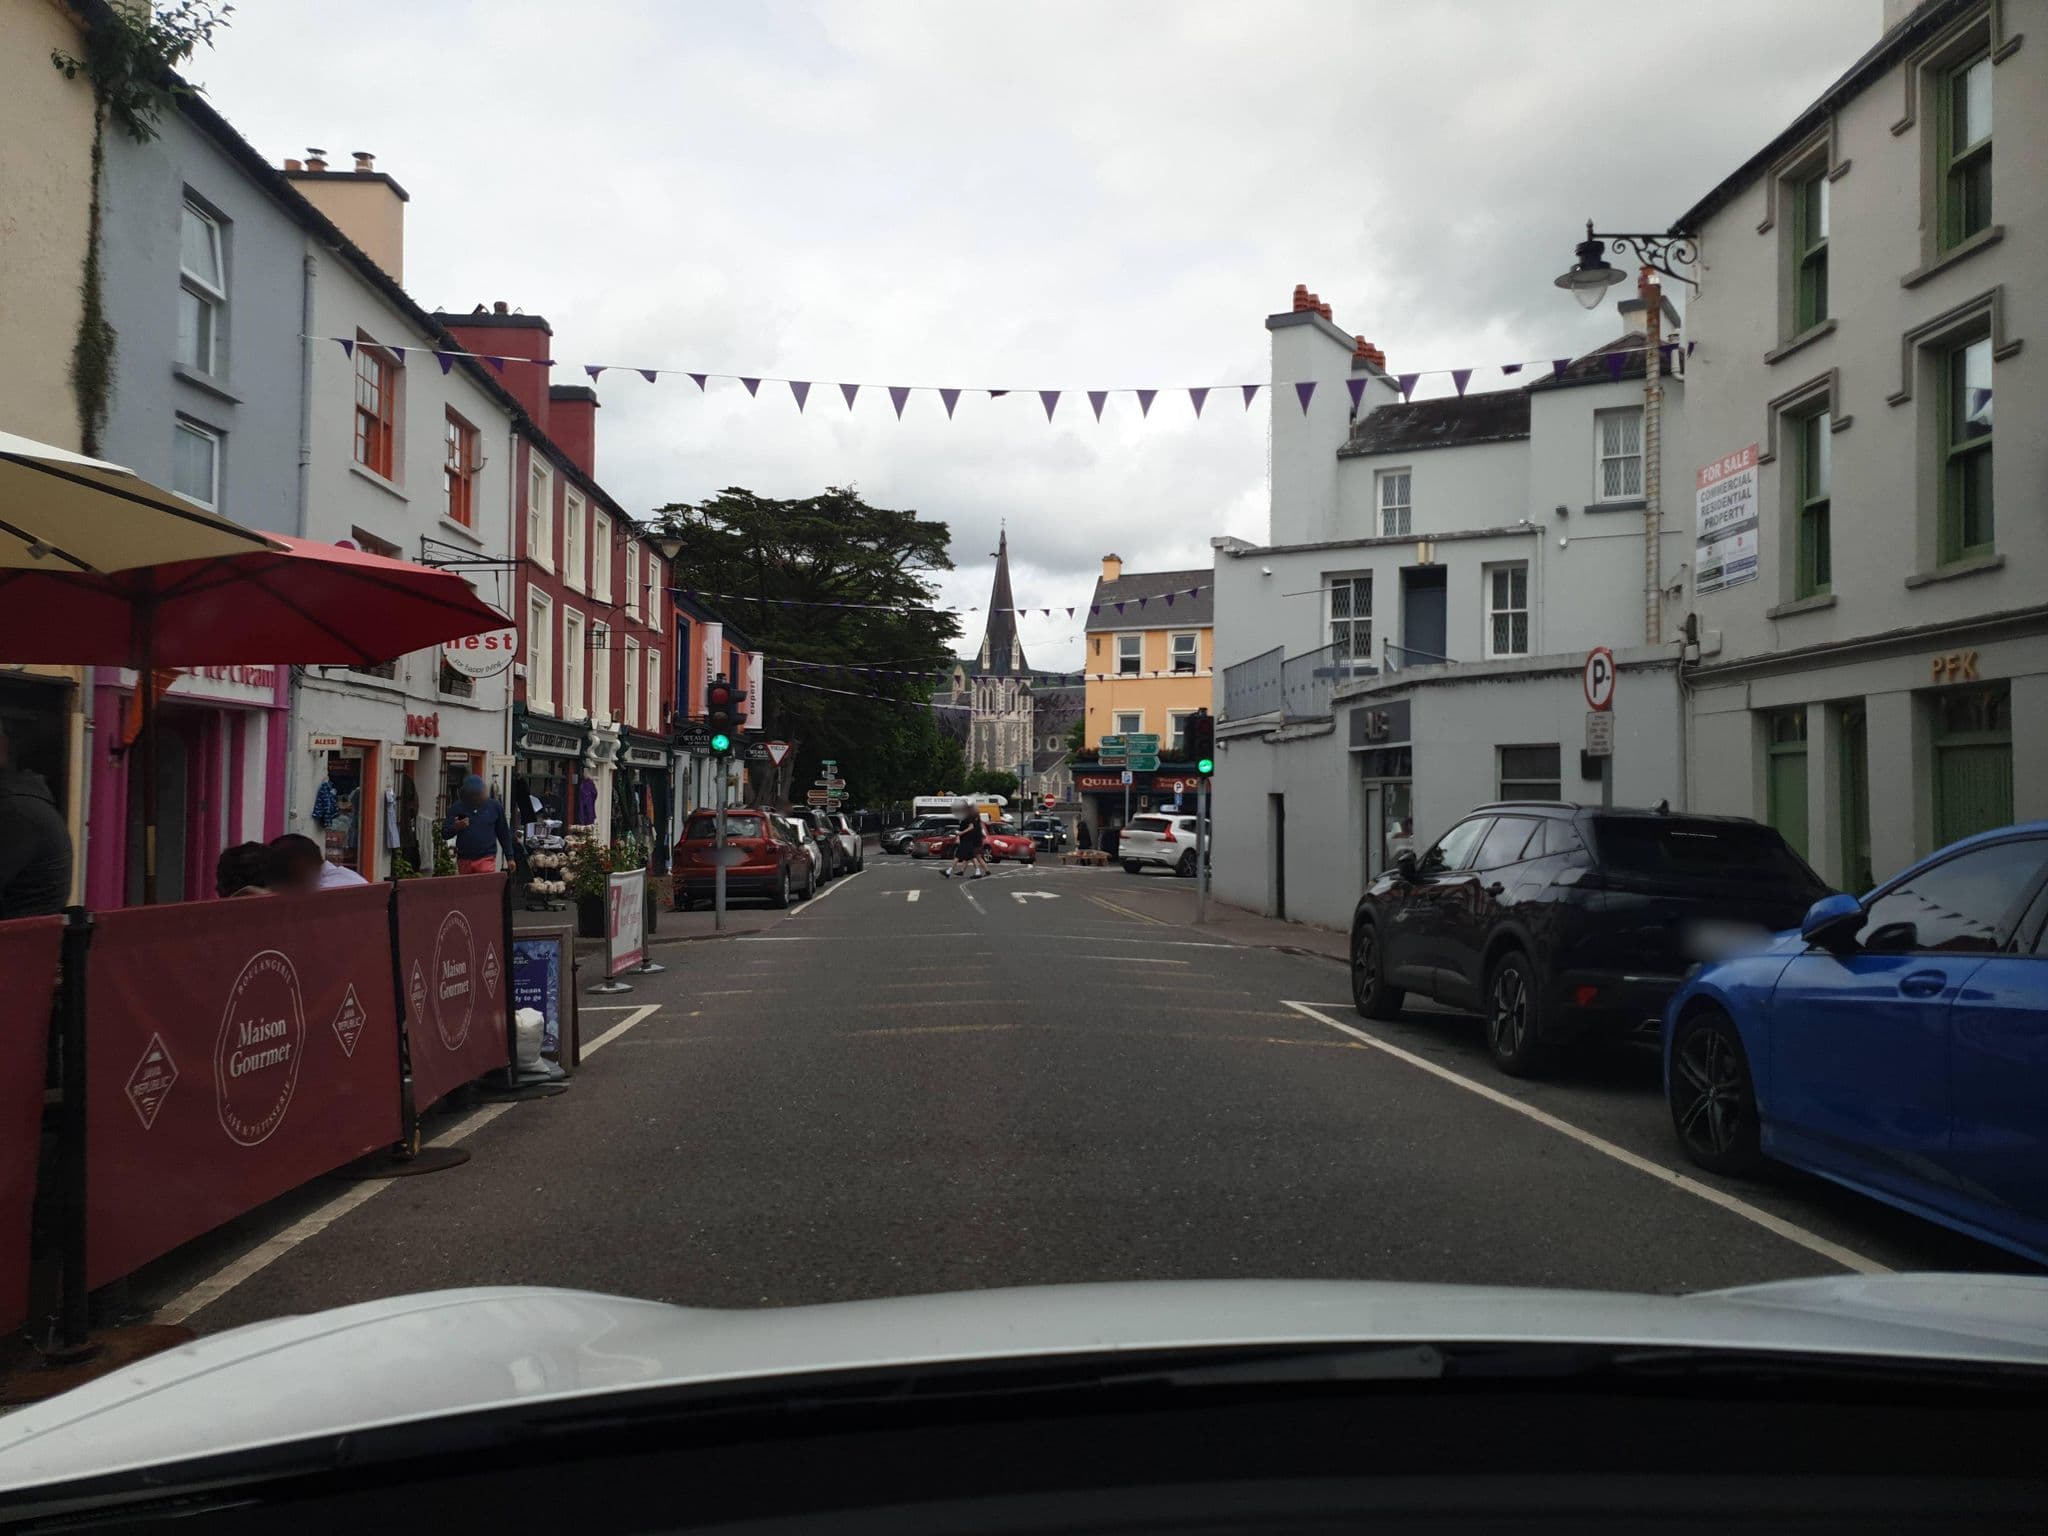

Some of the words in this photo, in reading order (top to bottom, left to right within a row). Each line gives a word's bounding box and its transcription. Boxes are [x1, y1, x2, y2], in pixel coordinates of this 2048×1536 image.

[1703, 465, 1721, 484] FOR
[1724, 450, 1750, 475] SALE
[1700, 473, 1752, 503] COMMERCIAL
[1700, 487, 1752, 516] RESIDENTIAL
[1704, 504, 1745, 529] PROPERTY
[446, 633, 512, 650] nest
[1593, 659, 1605, 698] P
[1931, 651, 1978, 682] PFK
[406, 712, 439, 737] nest
[314, 738, 337, 746] ALESSI
[1082, 777, 1123, 787] QUILL
[442, 959, 467, 979] Maison
[440, 979, 470, 1001] Gourmet
[236, 1017, 287, 1049] Maison
[229, 1042, 292, 1078] Gourmet
